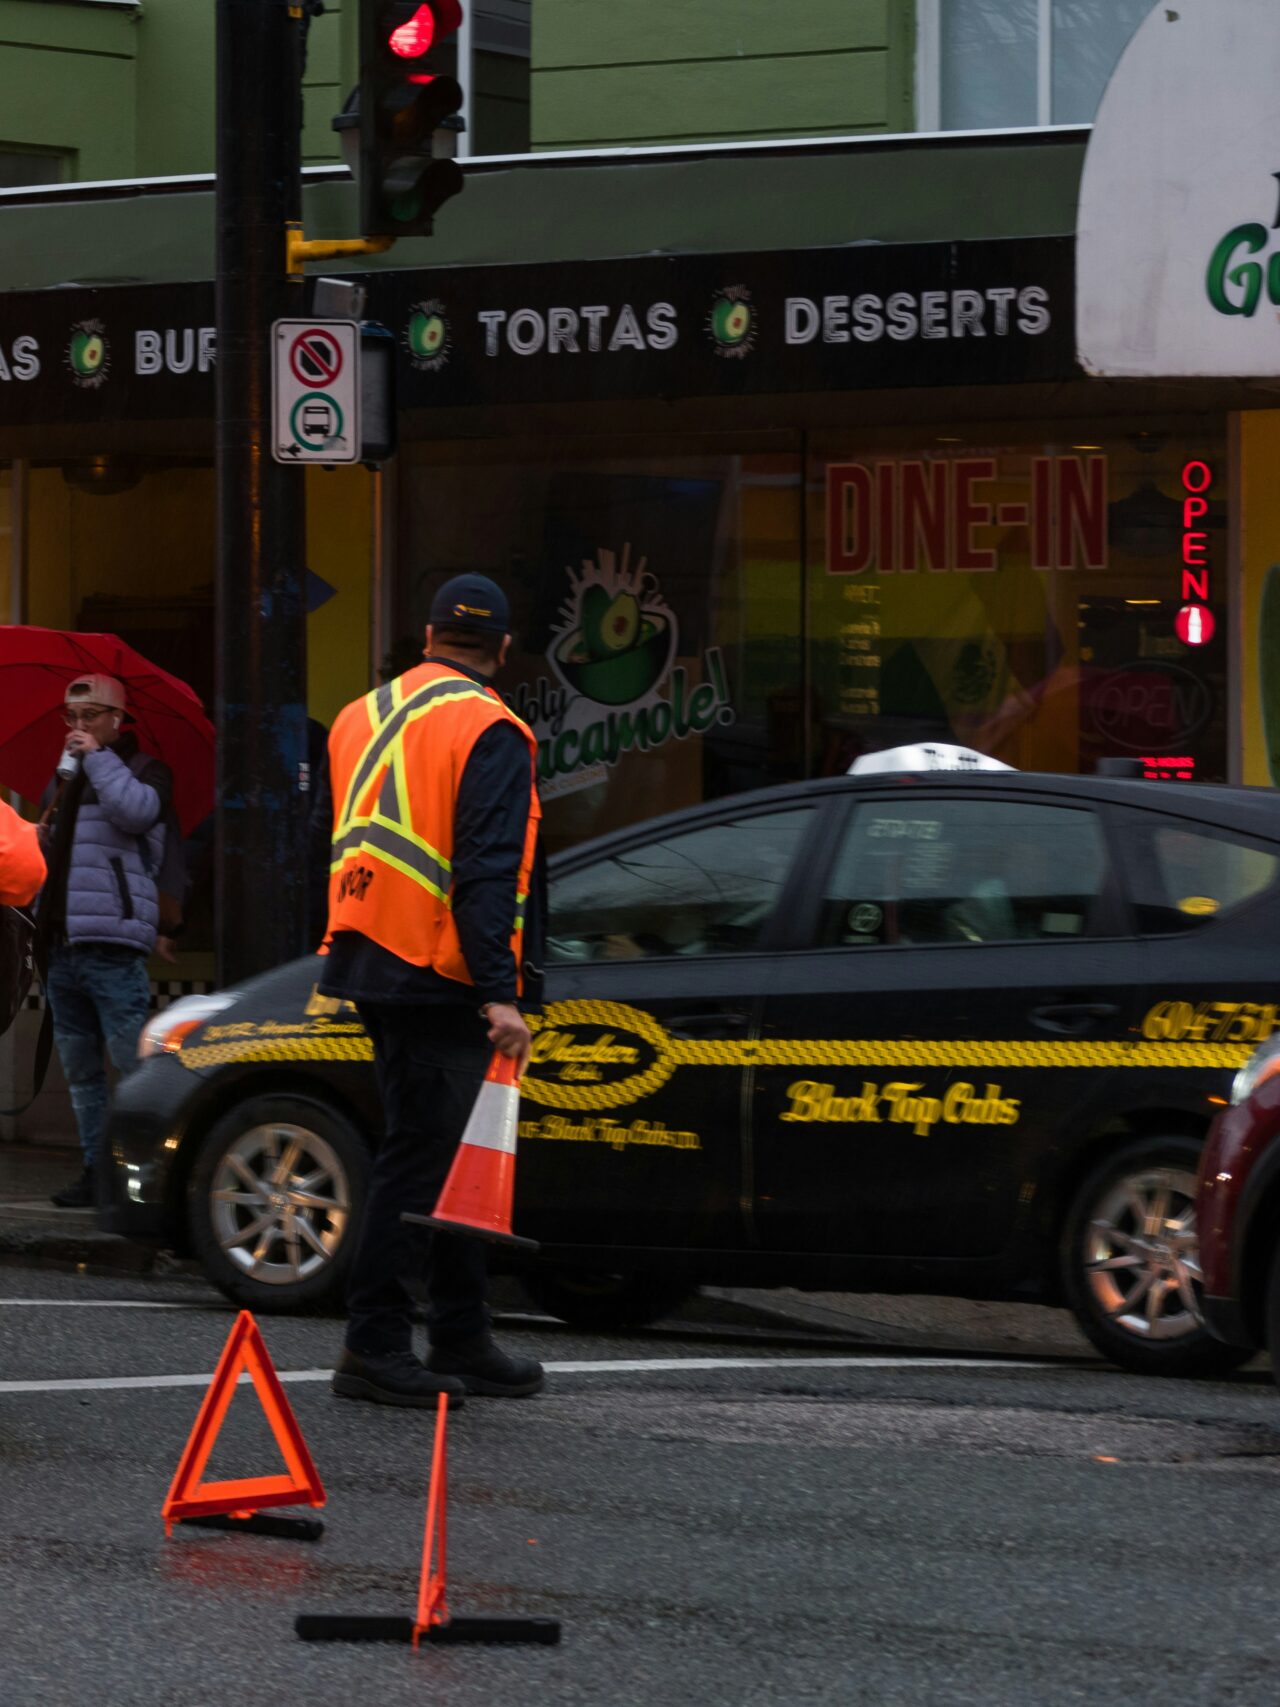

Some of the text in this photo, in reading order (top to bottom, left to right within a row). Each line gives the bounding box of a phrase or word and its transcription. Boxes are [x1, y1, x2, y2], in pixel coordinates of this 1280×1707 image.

[477, 302, 680, 358] TORTAS
[783, 285, 1052, 346] DESSERTS
[825, 454, 1109, 576] DINE-IN
[1181, 459, 1213, 602] OPEN
[1099, 684, 1200, 728] OPEN
[777, 1080, 1023, 1137] Black Top Cabs
